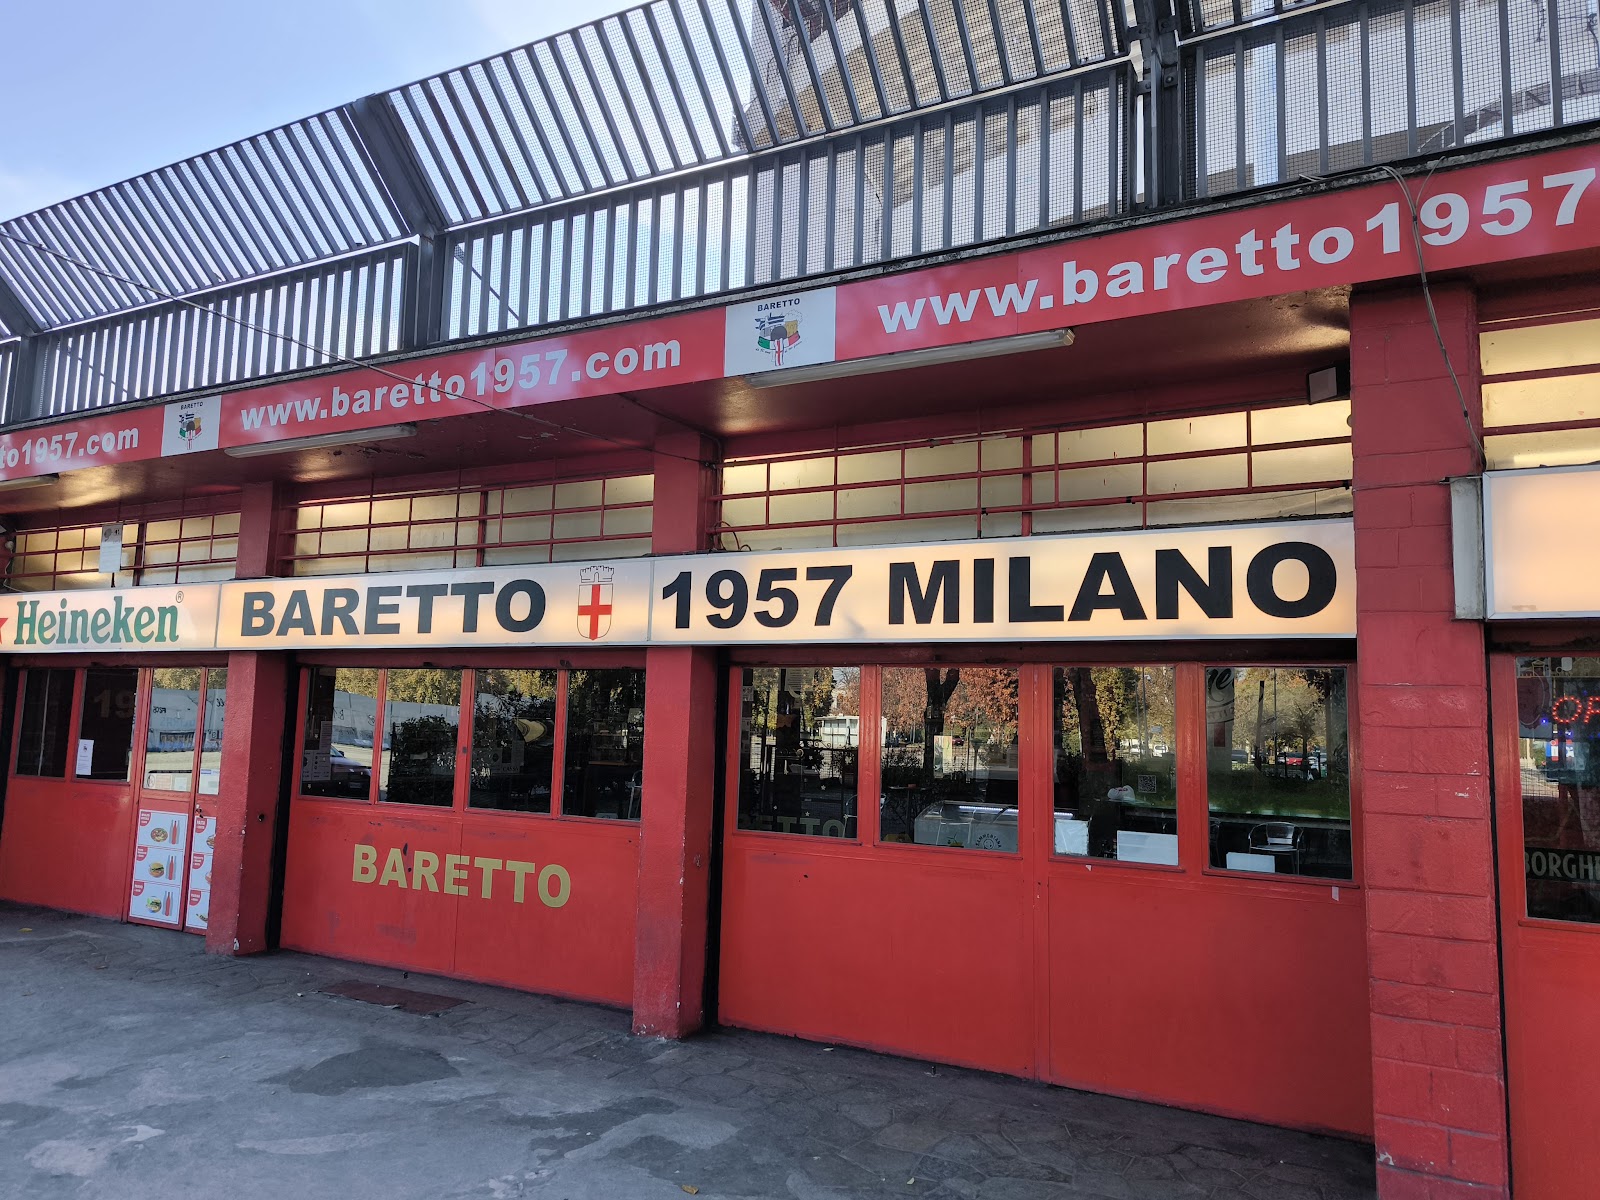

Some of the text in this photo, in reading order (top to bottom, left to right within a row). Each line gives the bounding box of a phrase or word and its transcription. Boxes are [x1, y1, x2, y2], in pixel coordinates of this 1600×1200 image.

[877, 167, 1597, 334] www.baretto1957
[757, 298, 801, 312] BARETTO
[180, 402, 204, 411] BARETTO
[241, 339, 681, 430] www.baretto1957.com
[240, 541, 1337, 637] BARETTO 1957 MILANO
[352, 843, 571, 908] BARETTO
